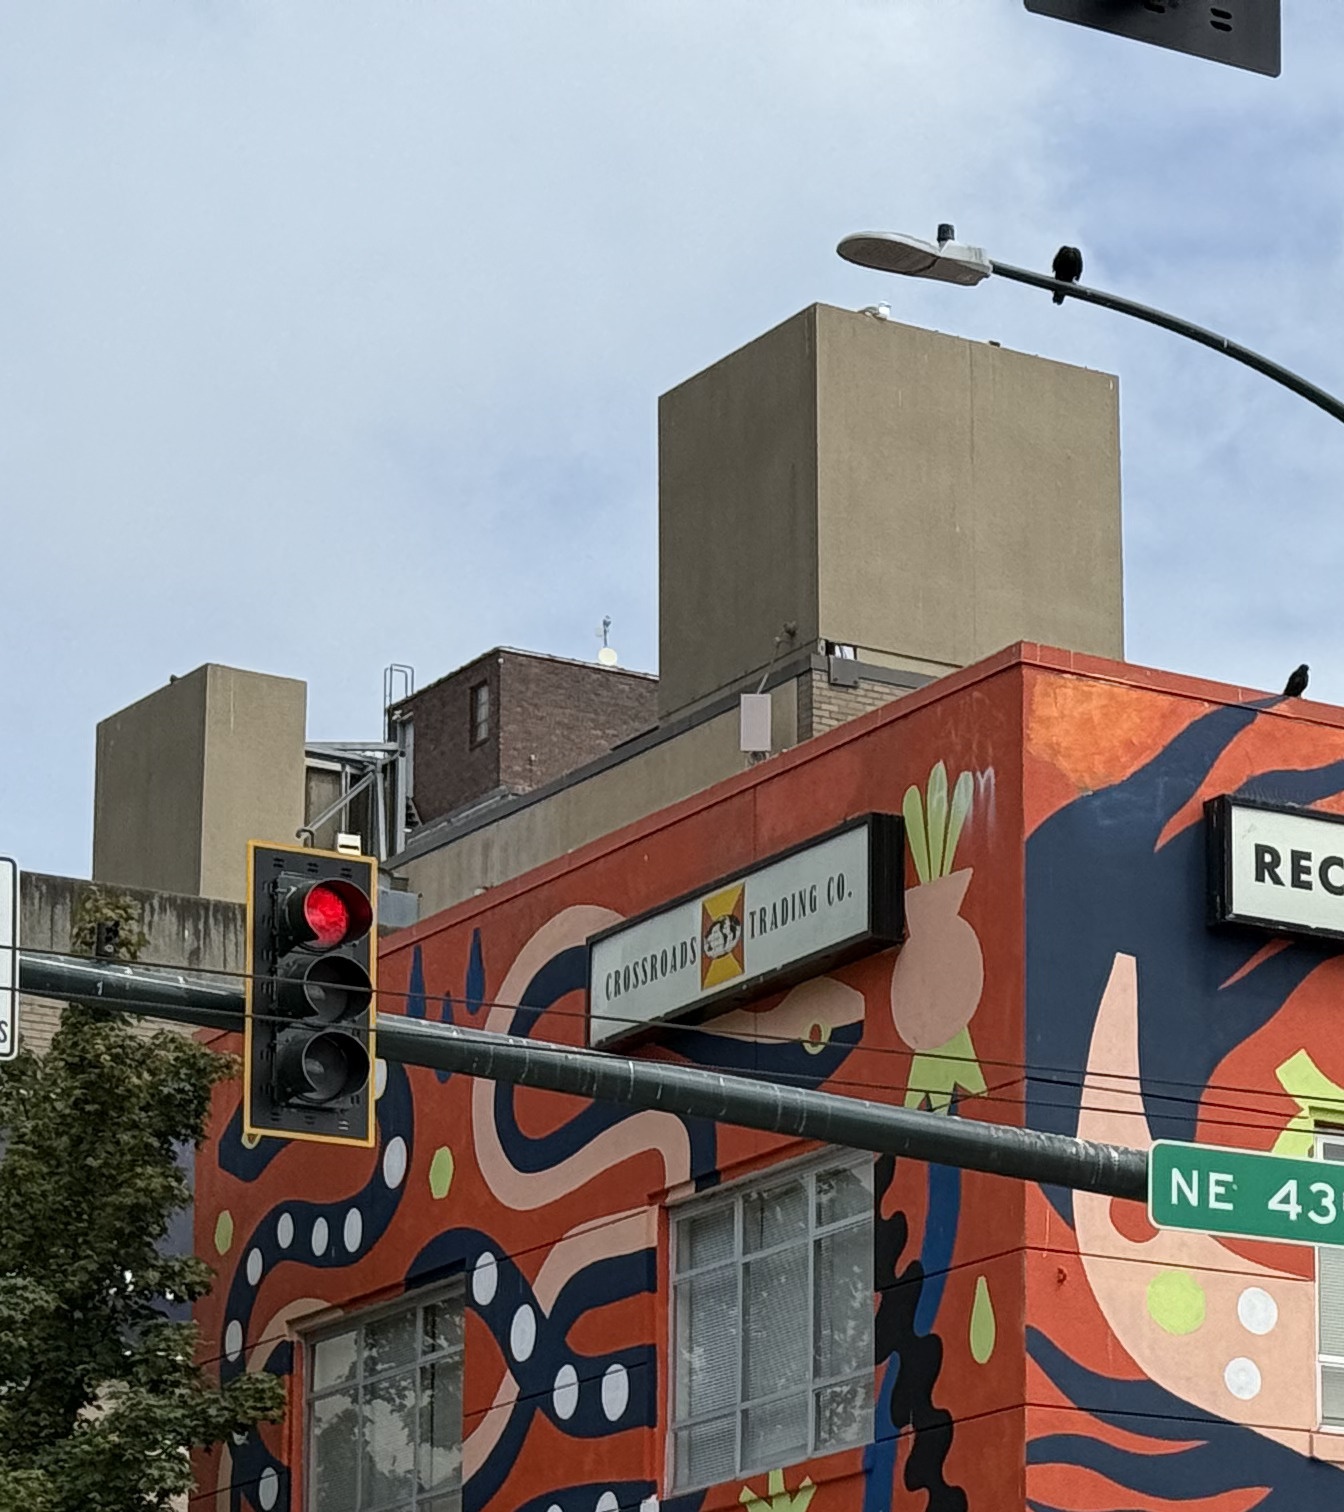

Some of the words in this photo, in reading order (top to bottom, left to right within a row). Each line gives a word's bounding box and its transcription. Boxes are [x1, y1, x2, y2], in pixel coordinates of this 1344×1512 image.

[605, 936, 697, 1001] CROSSROADS
[749, 884, 817, 940] TRADING
[827, 872, 854, 907] CO.
[1171, 1168, 1234, 1211] NE
